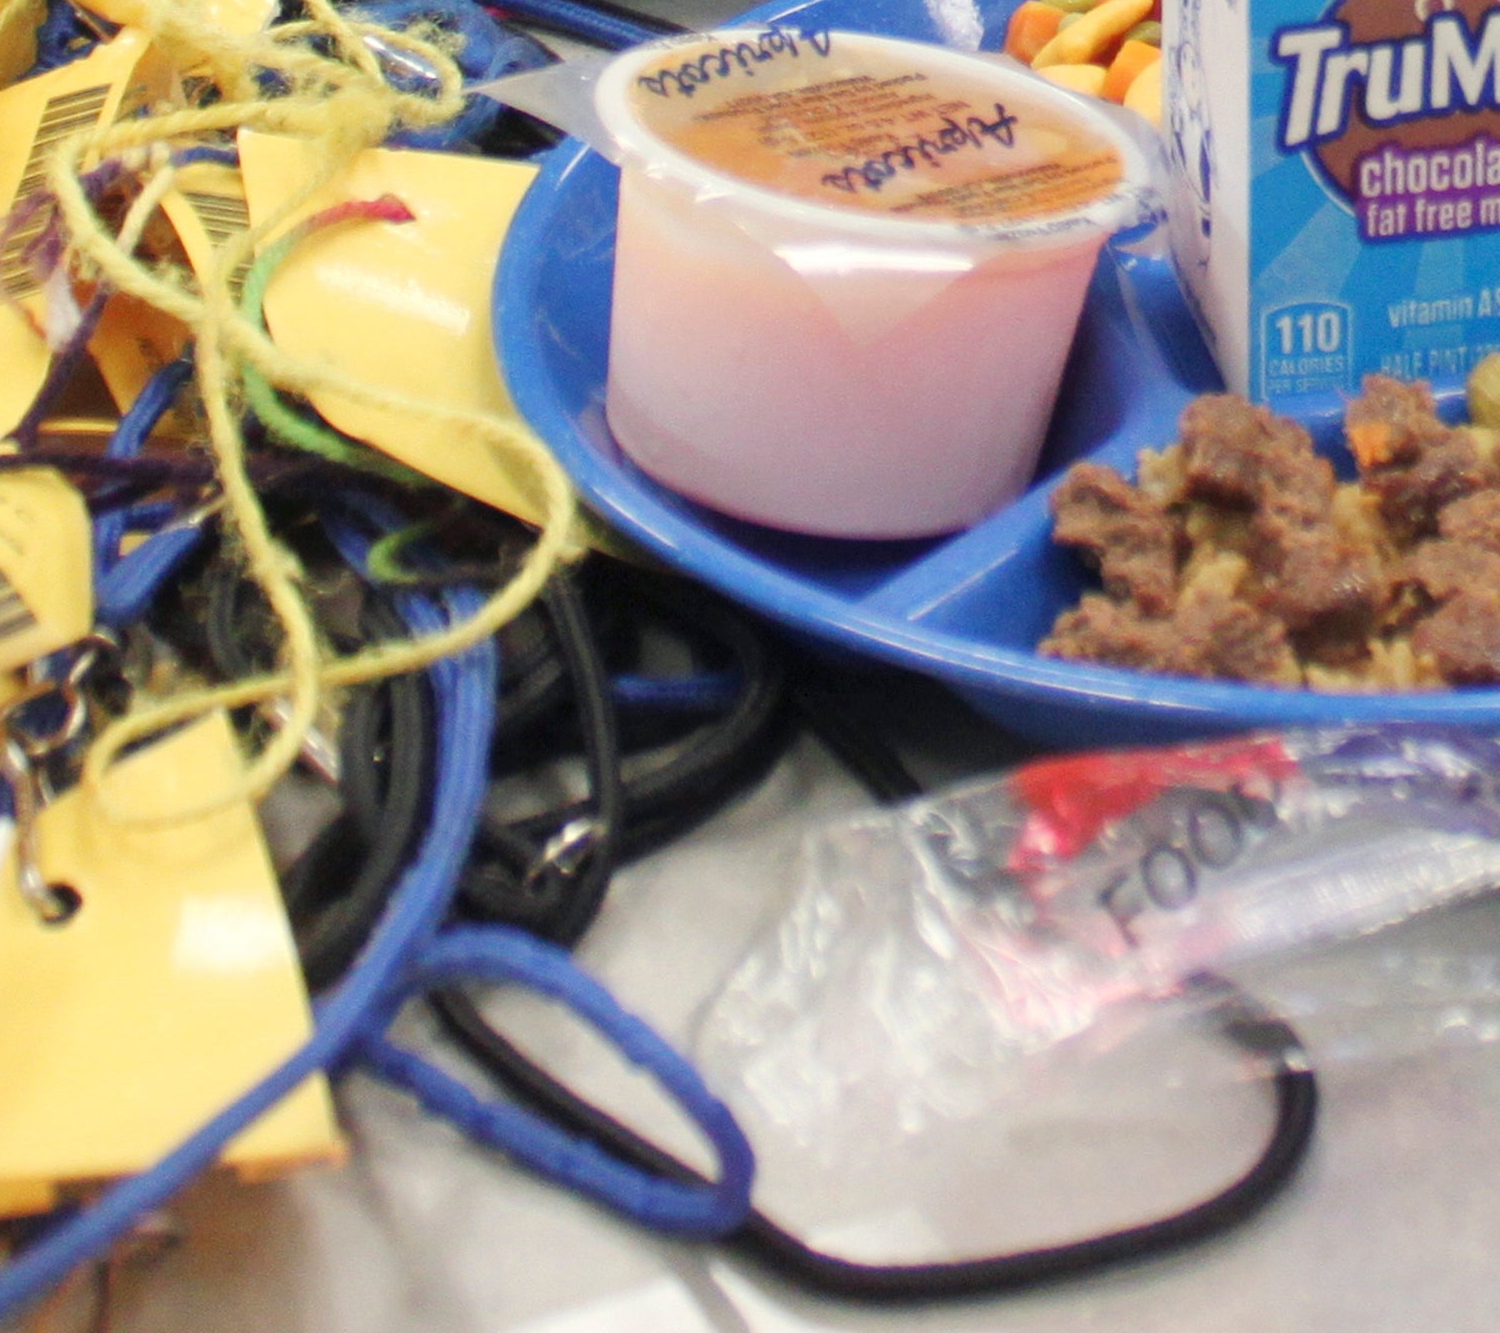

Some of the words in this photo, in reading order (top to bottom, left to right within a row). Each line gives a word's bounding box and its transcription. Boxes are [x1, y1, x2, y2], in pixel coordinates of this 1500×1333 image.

[638, 25, 832, 98] Apricots
[822, 102, 1019, 194] Apricots
[1366, 202, 1406, 237] fat
[1414, 196, 1473, 233] free
[1388, 294, 1473, 327] vitamin
[1275, 311, 1341, 355] 110
[1268, 355, 1345, 376] CALORIES
